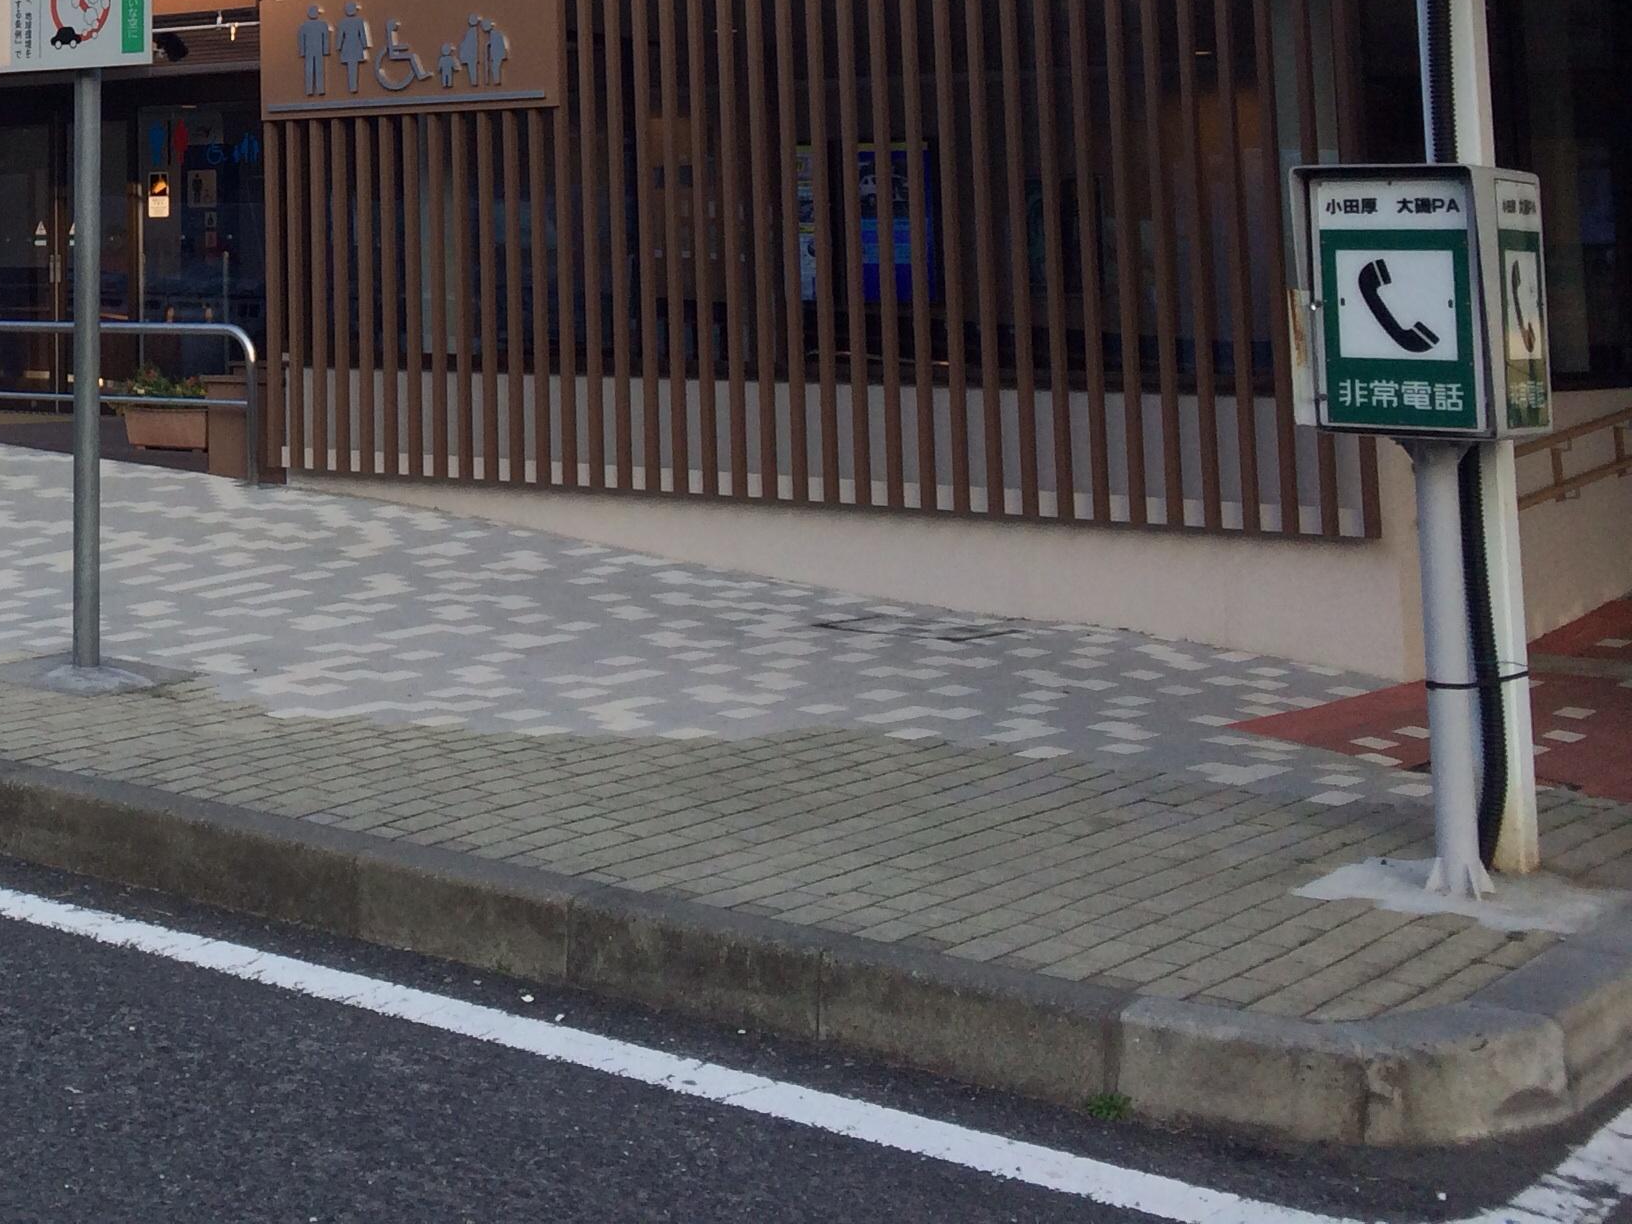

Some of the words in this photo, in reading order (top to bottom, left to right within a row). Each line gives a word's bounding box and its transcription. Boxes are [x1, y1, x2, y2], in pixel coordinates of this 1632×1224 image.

[1325, 197, 1378, 214] 小田厚
[1396, 197, 1461, 214] 大磯PA
[1338, 378, 1465, 412] 非常電話
